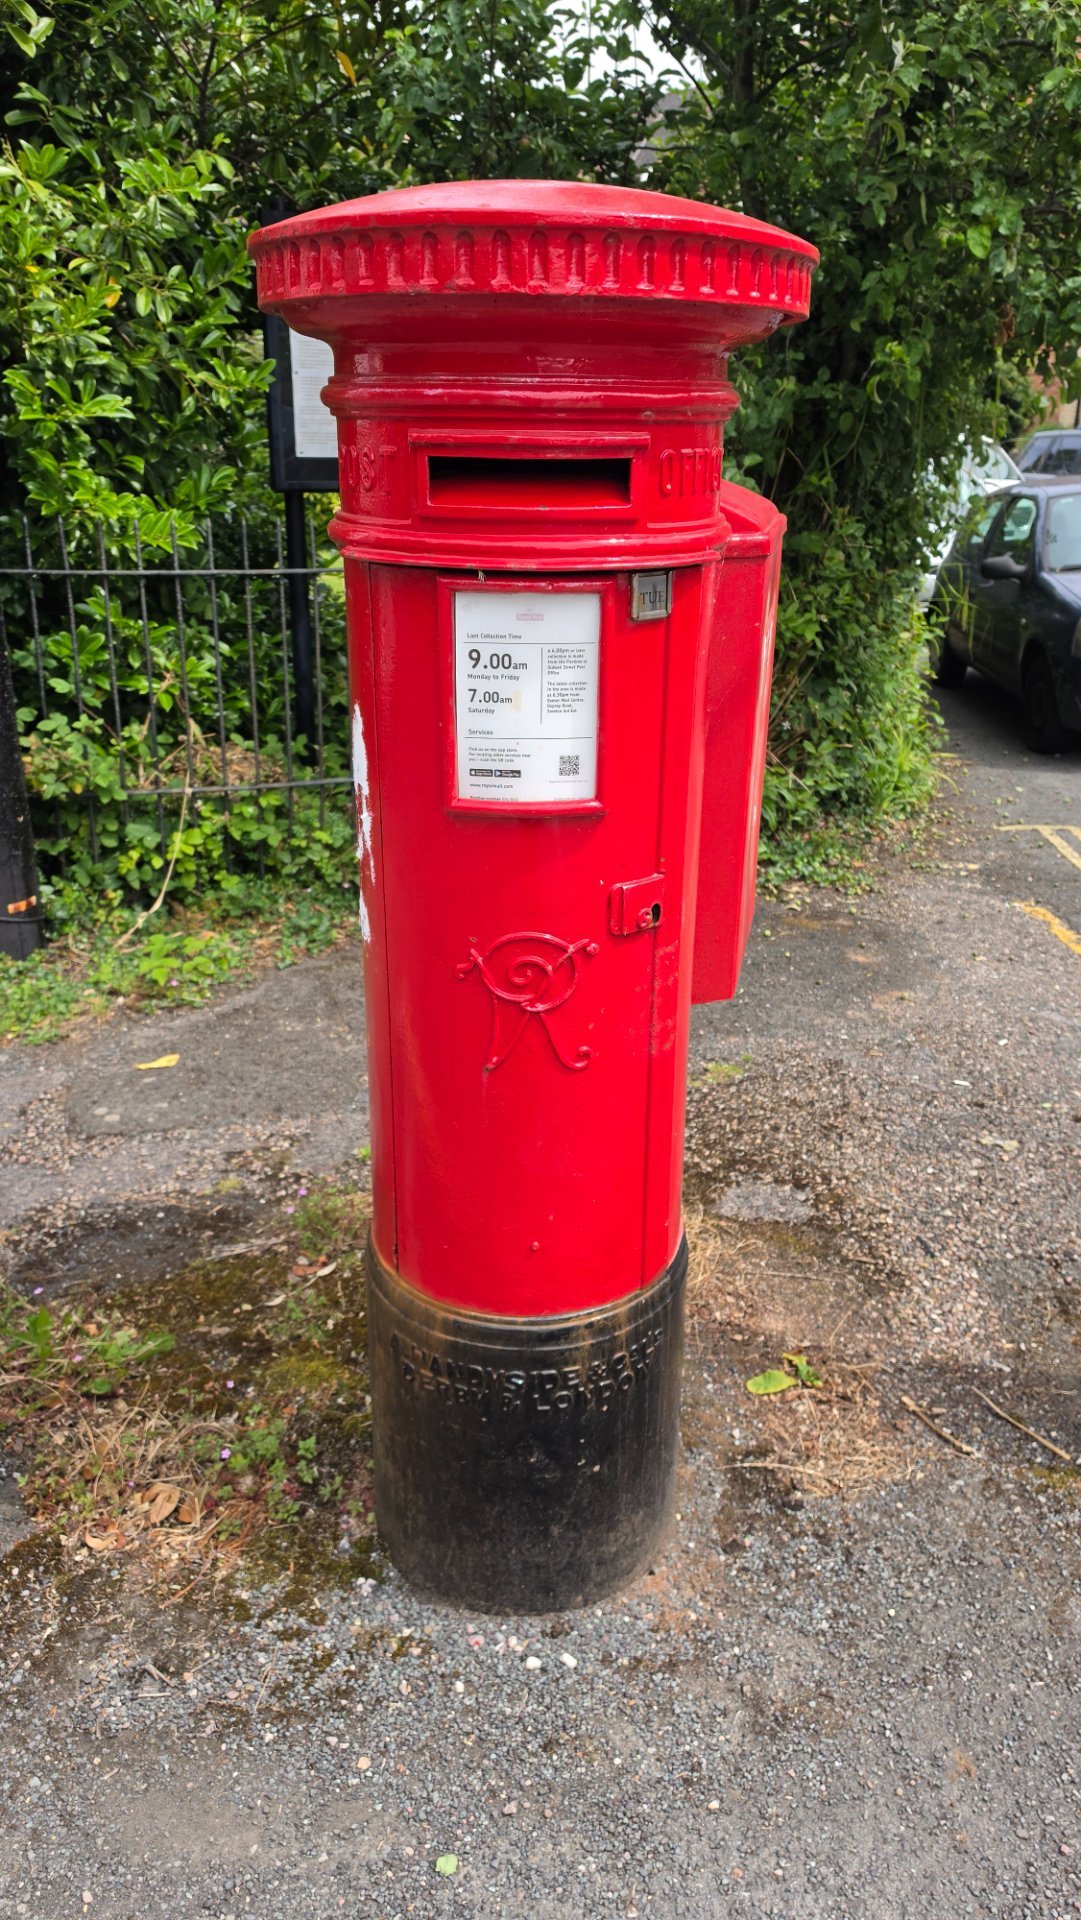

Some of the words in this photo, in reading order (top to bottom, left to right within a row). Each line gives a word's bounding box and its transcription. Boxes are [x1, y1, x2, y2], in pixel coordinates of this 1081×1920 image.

[640, 591, 665, 604] TUE
[468, 648, 528, 670] 9.00am
[468, 688, 513, 704] 7.00am
[468, 707, 495, 715] Saturday
